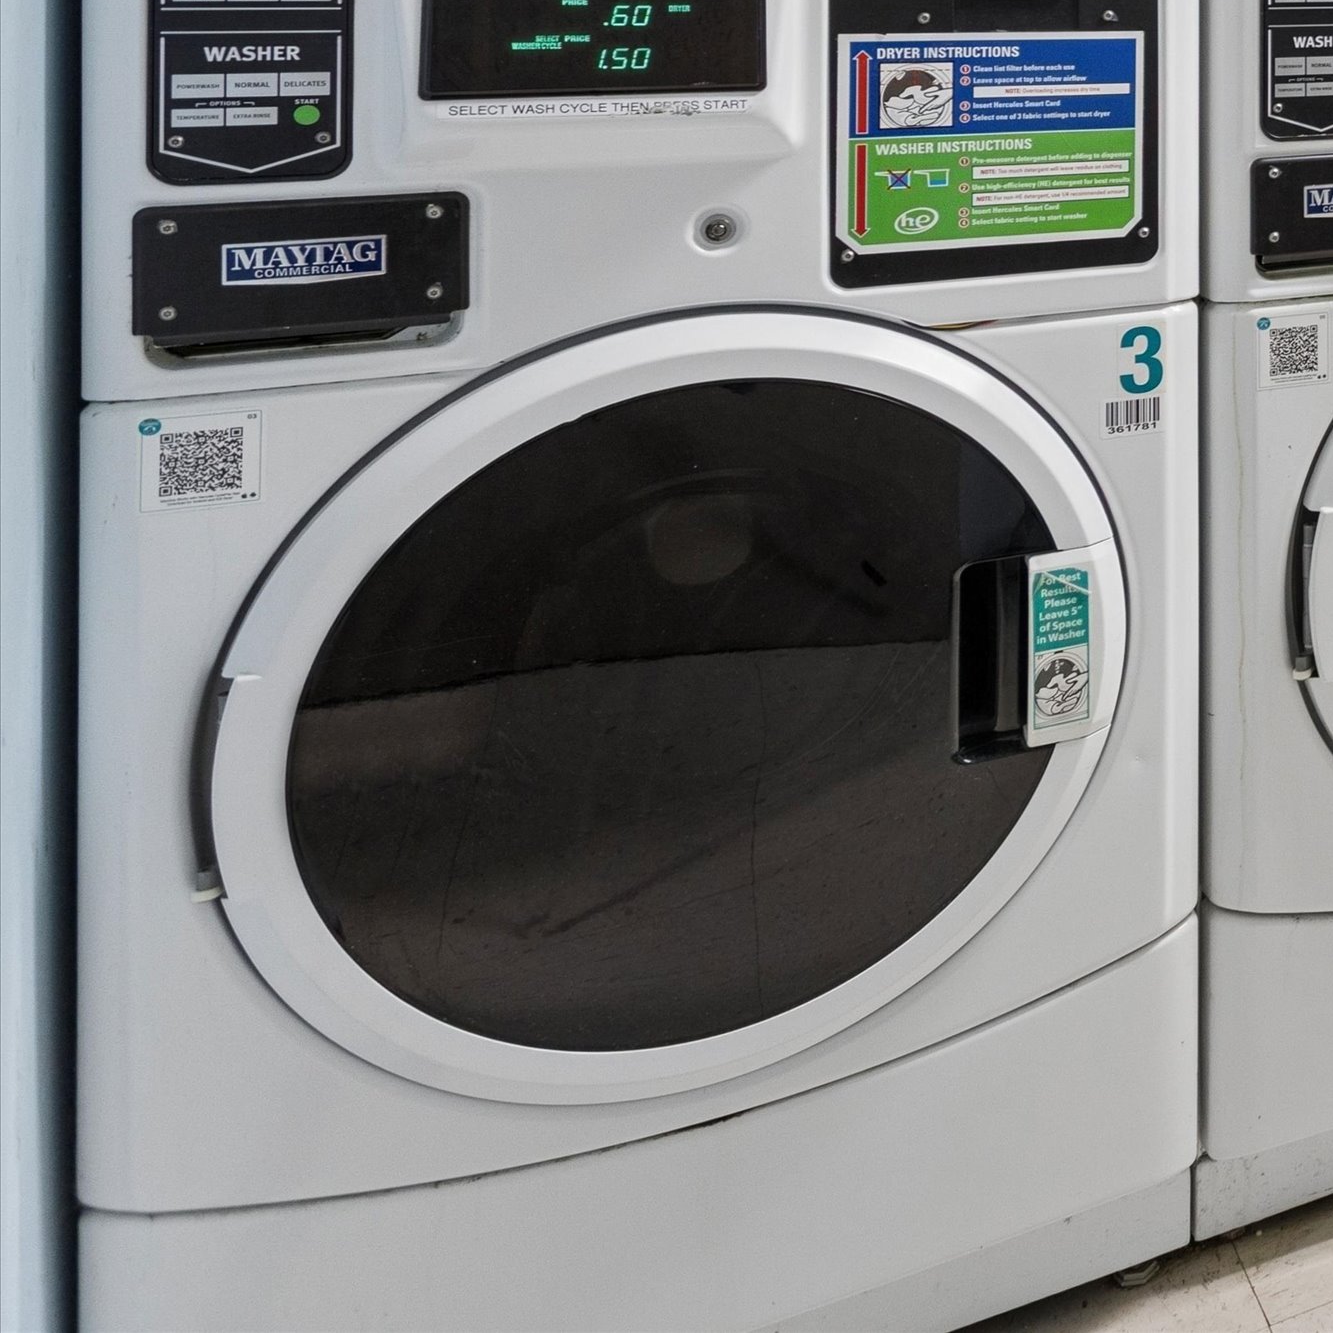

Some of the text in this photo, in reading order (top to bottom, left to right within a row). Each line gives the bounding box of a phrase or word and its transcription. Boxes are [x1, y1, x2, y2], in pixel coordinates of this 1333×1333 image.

[603, 5, 652, 27] .60
[668, 4, 691, 13] DRYER
[203, 45, 301, 63] WASHER
[598, 47, 651, 70] 1.50
[876, 46, 1020, 60] DRYER INSTRUCTIONS
[234, 80, 327, 89] NORMAL DELICATES
[448, 104, 507, 117] SELECT
[511, 102, 556, 115] WASH
[559, 101, 608, 114] CYCLE
[611, 101, 649, 113] THEN
[703, 99, 748, 111] START
[875, 138, 1033, 157] WASHER INSTRUCTIONS
[231, 241, 378, 271] MAYTAG
[254, 264, 353, 279] COMMERCIAL
[1119, 326, 1164, 394] 3
[1107, 421, 1157, 435] 361781
[1044, 597, 1077, 609] Please
[1038, 609, 1069, 621] Leave
[1039, 618, 1083, 633] of Space
[1036, 629, 1086, 644] in Washer
